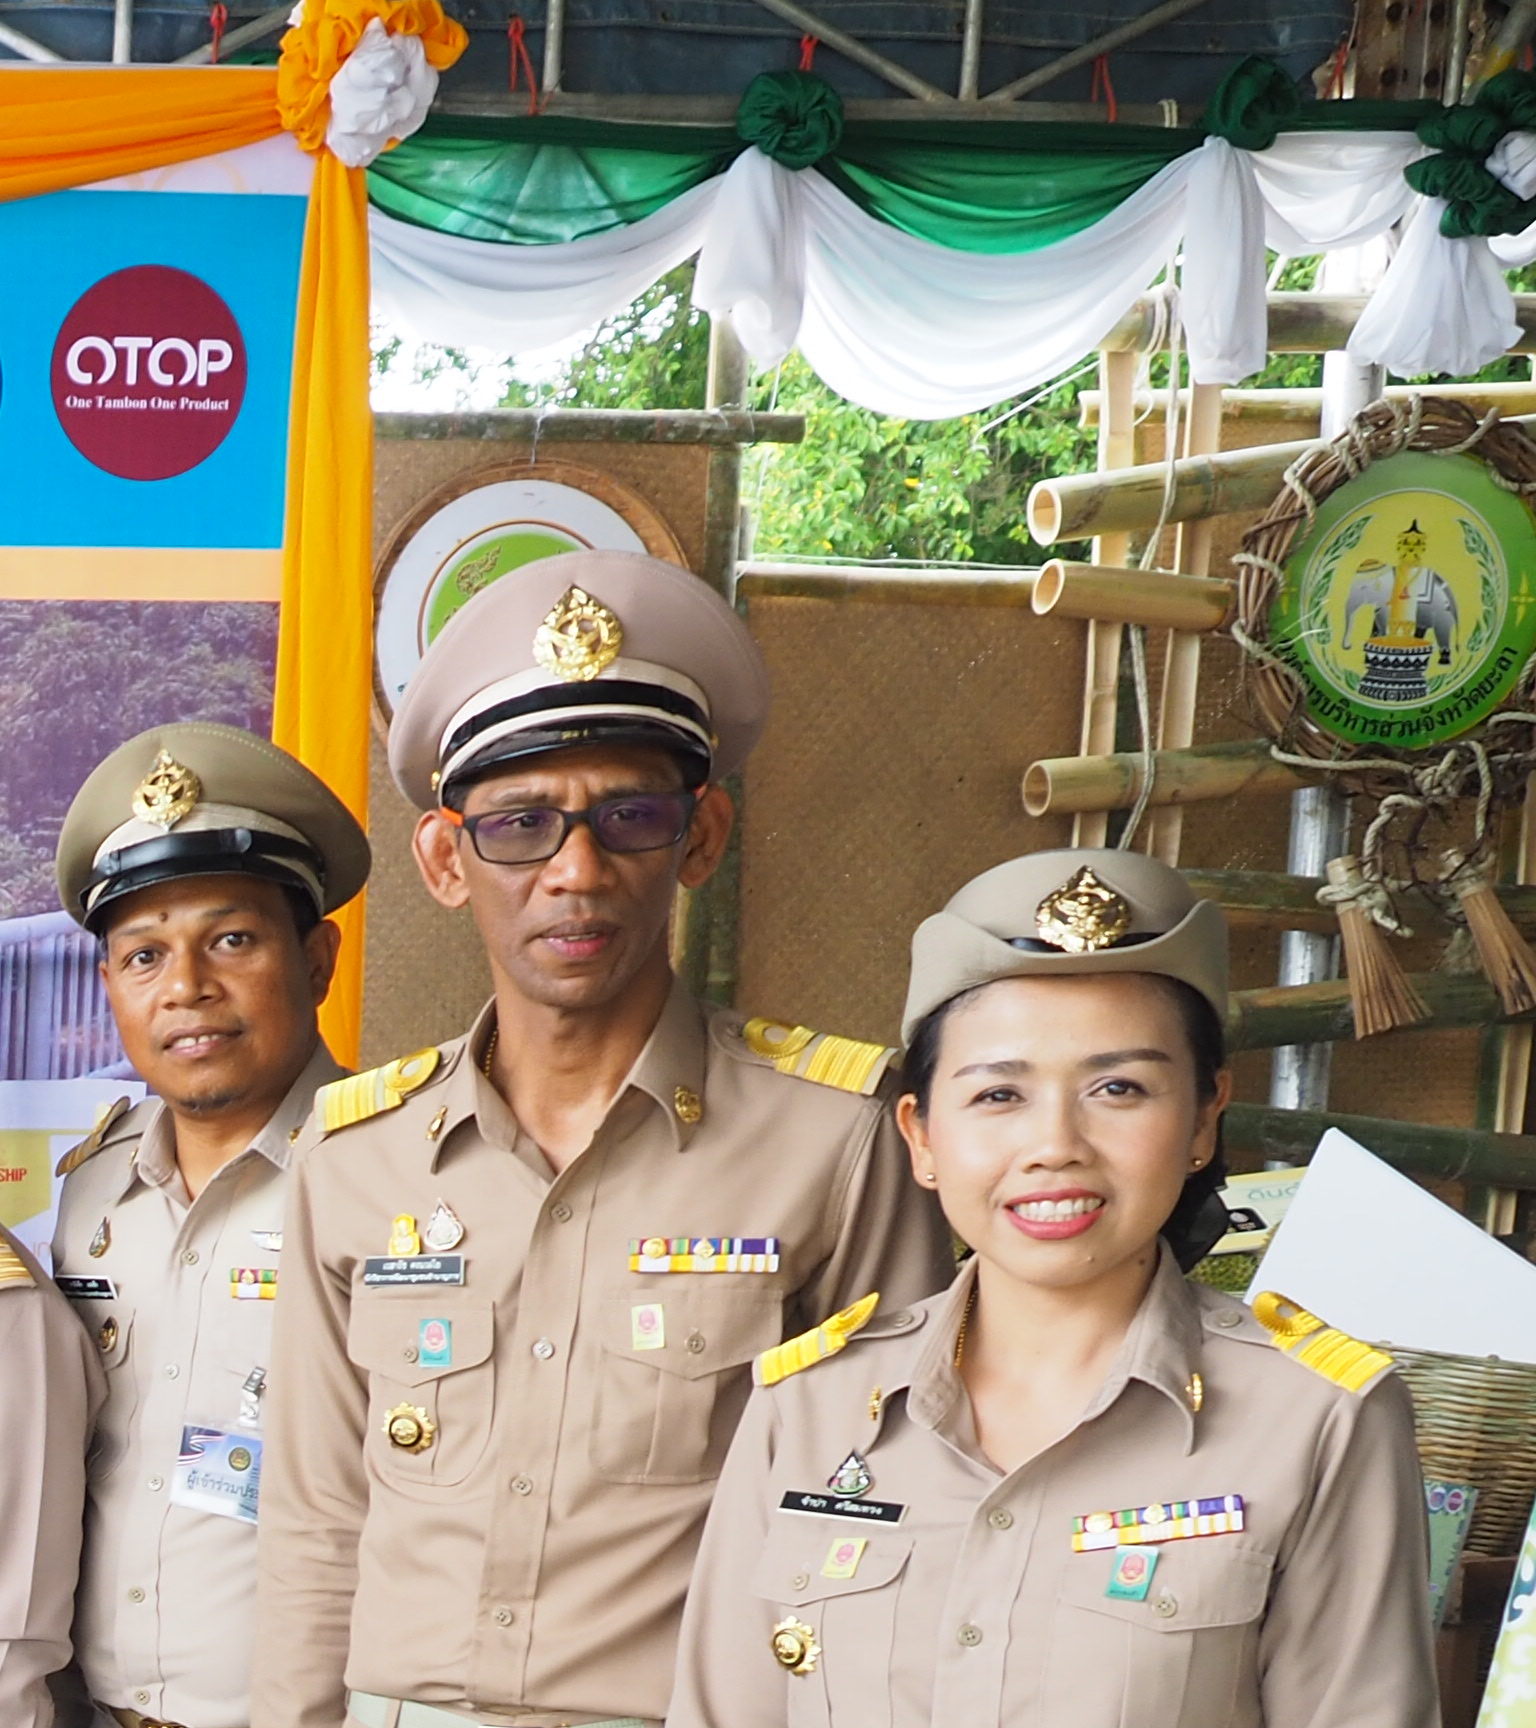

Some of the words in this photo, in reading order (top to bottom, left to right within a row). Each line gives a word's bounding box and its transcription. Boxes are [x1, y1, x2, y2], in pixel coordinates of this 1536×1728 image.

[65, 335, 234, 387] OTOP
[66, 394, 93, 409] One
[95, 395, 148, 411] Tambon
[150, 396, 177, 411] One
[180, 396, 230, 412] Product
